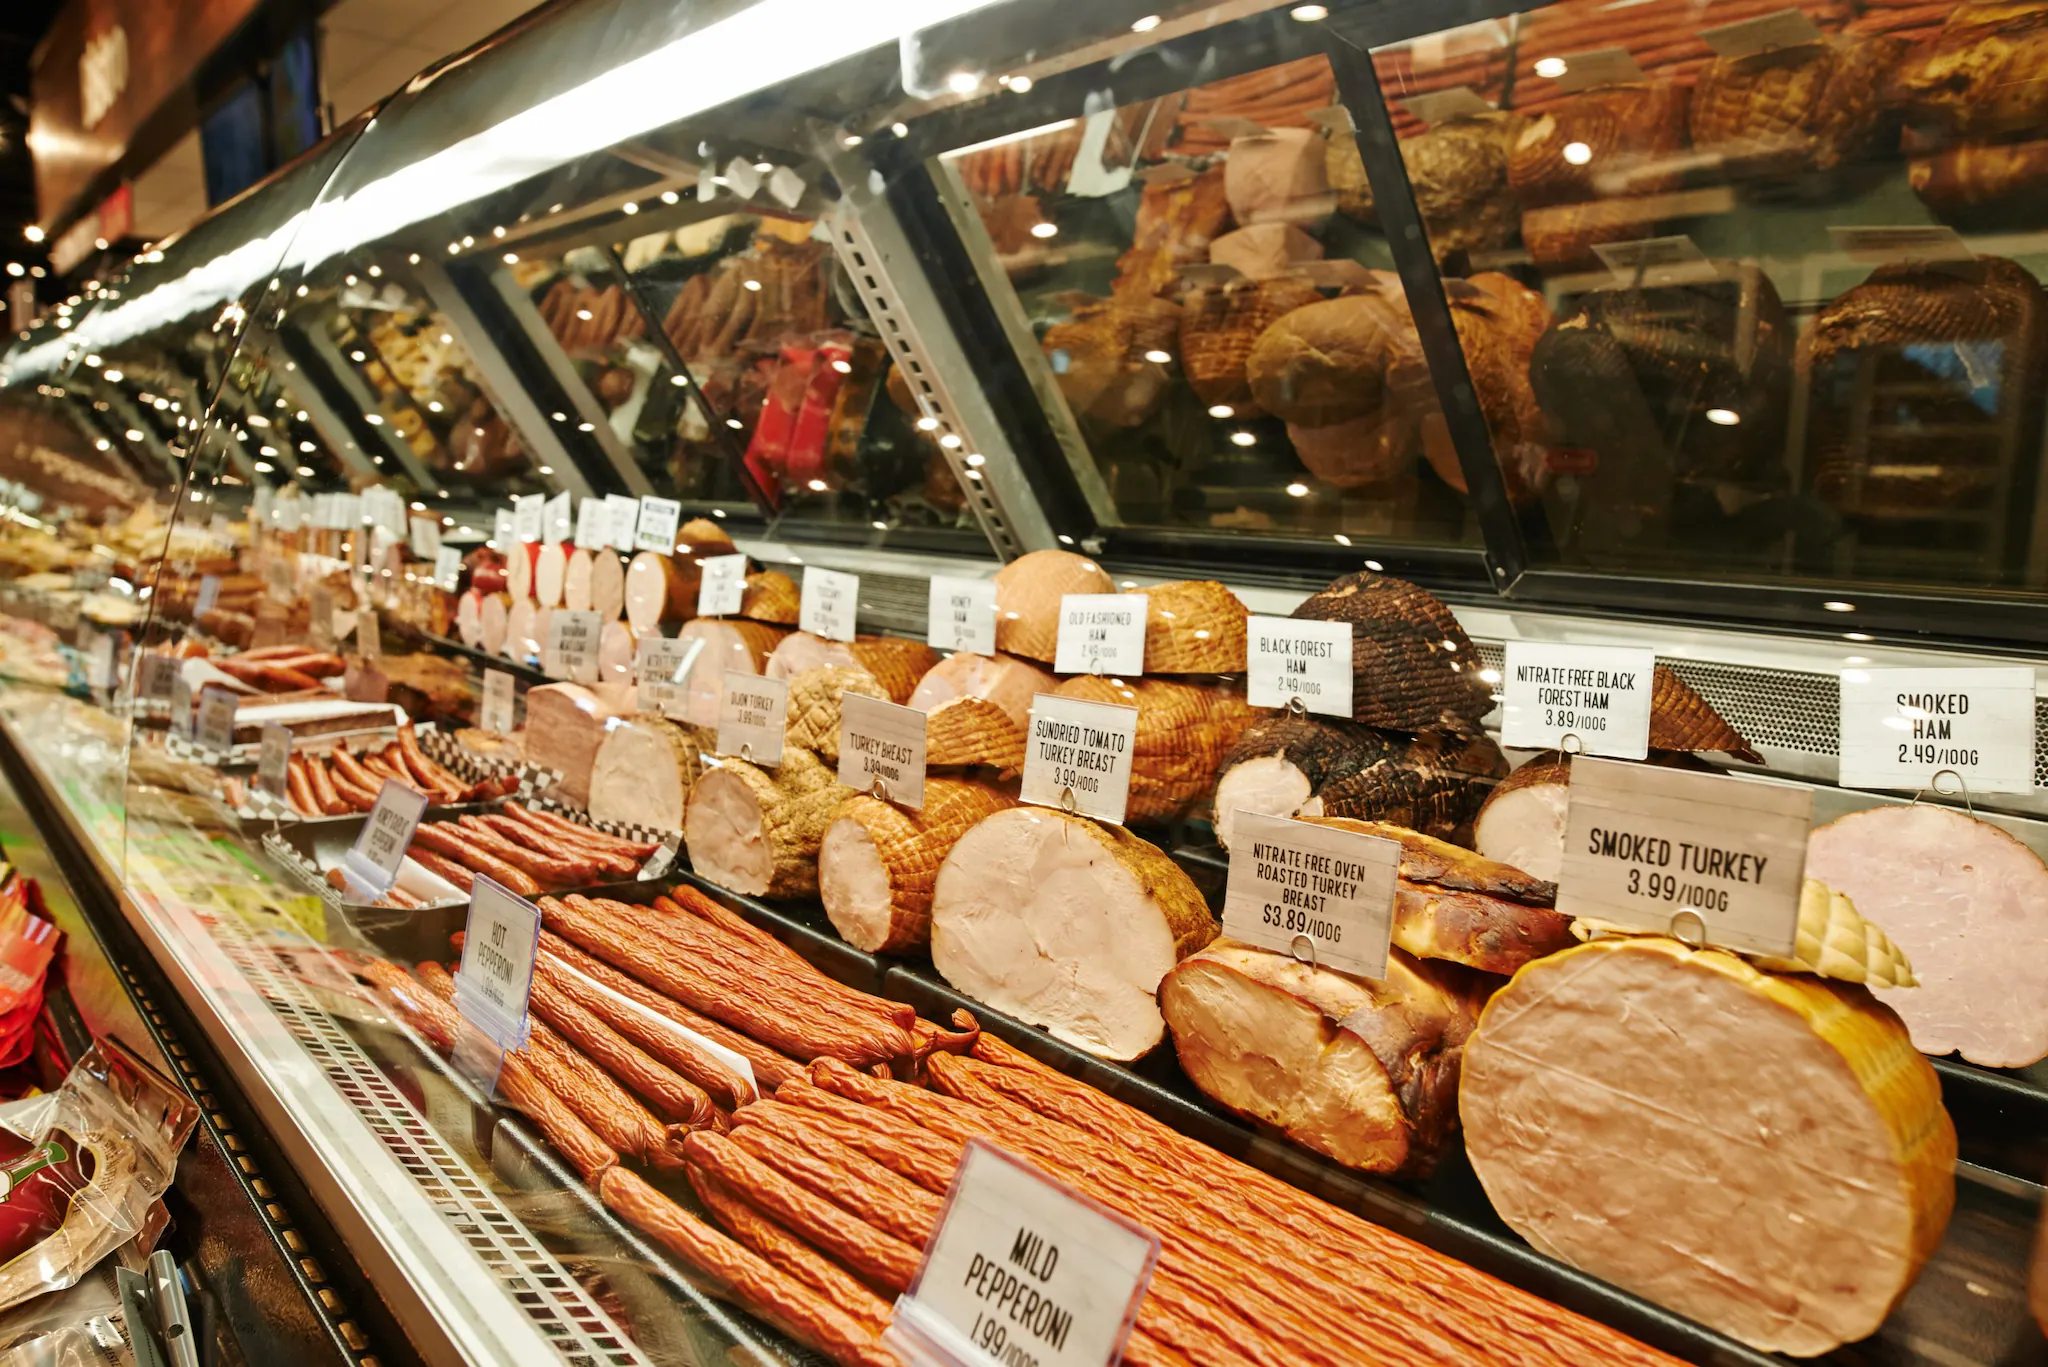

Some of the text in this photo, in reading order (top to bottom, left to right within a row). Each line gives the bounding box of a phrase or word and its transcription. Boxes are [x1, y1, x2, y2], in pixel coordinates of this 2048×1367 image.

[1069, 612, 1132, 626] OLD FASHIONED
[1088, 628, 1106, 640] HAM
[1260, 637, 1333, 658] BLACK FOREST
[1286, 658, 1306, 674] HAM
[1517, 665, 1636, 690] NITRATE FREE BLACK
[1278, 676, 1321, 695] 2.49/100G
[1538, 688, 1609, 710] FOREST HAM
[1897, 693, 1970, 715] SMOKED
[1545, 708, 1606, 731] 3.89/100G
[1914, 718, 1951, 740] HAM
[850, 732, 913, 766] TURKEY BREAST
[1036, 720, 1125, 752] SUNDRIED TOMATO
[1040, 742, 1116, 774] TURKEY BREAST
[1898, 744, 1979, 766] 2.49/100G
[1054, 766, 1099, 793] 3.99/100G
[1253, 842, 1366, 882] NITRATE FREE OVEN
[1588, 827, 1768, 885] SMOKED TURKEY
[1256, 862, 1357, 900] ROASTED TURKEY
[1627, 868, 1730, 913] 3.99/100G
[1282, 888, 1326, 913] BREAST
[491, 920, 508, 950] HOT
[1262, 903, 1342, 943] $3.89/100G
[477, 941, 514, 986] PEPPERONI
[1008, 1226, 1060, 1283] MILD
[964, 1252, 1074, 1353] PEPPERONI
